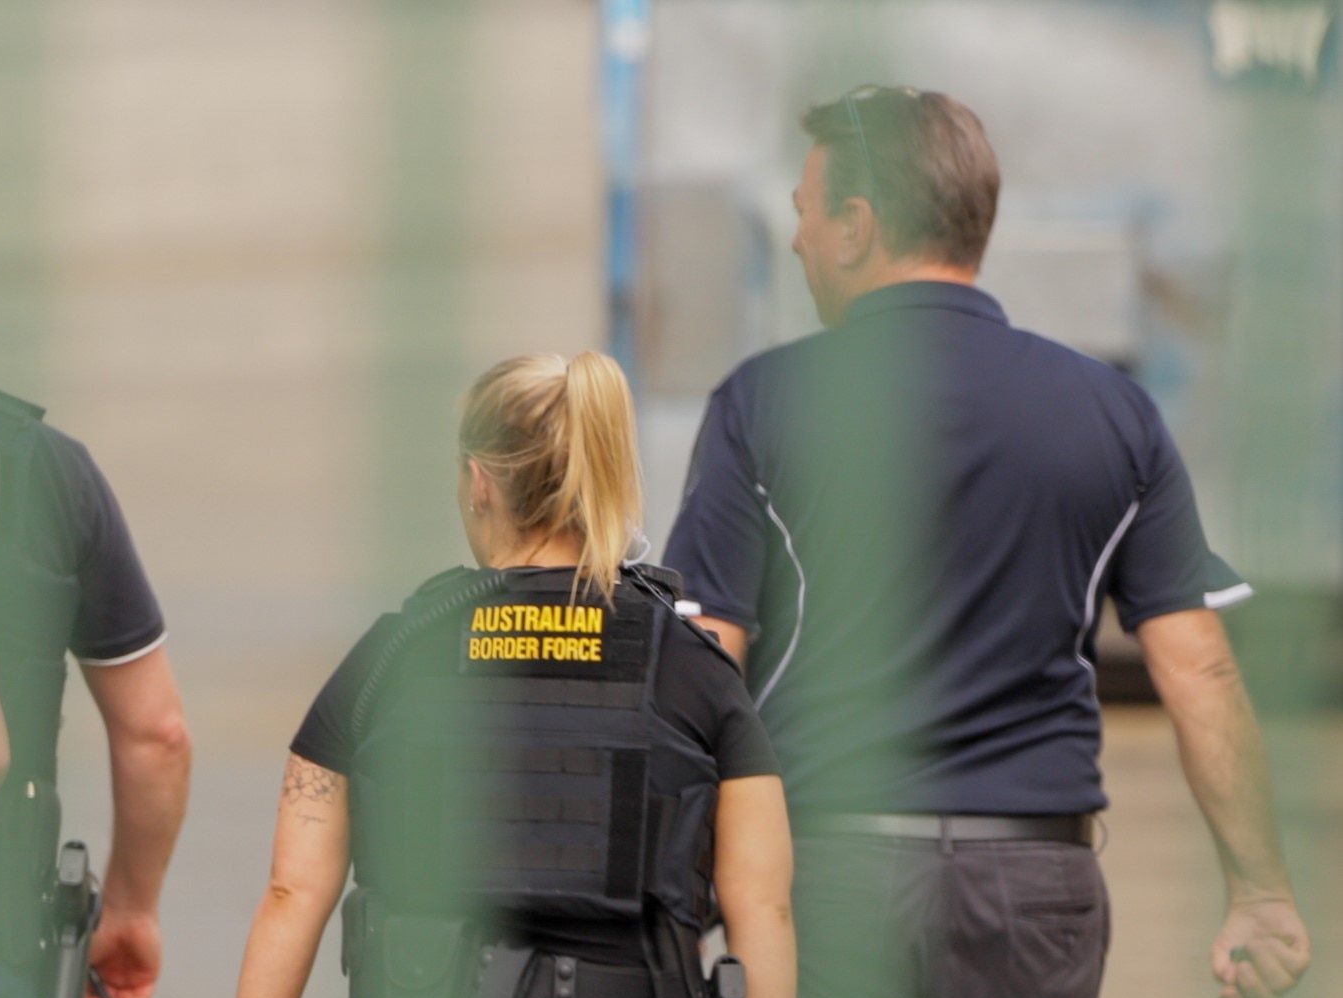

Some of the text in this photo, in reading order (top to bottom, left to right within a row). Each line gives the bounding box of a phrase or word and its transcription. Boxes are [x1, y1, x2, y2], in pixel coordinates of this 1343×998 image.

[470, 605, 604, 634] AUSTRALIAN
[469, 635, 602, 662] BORDER FORCE
